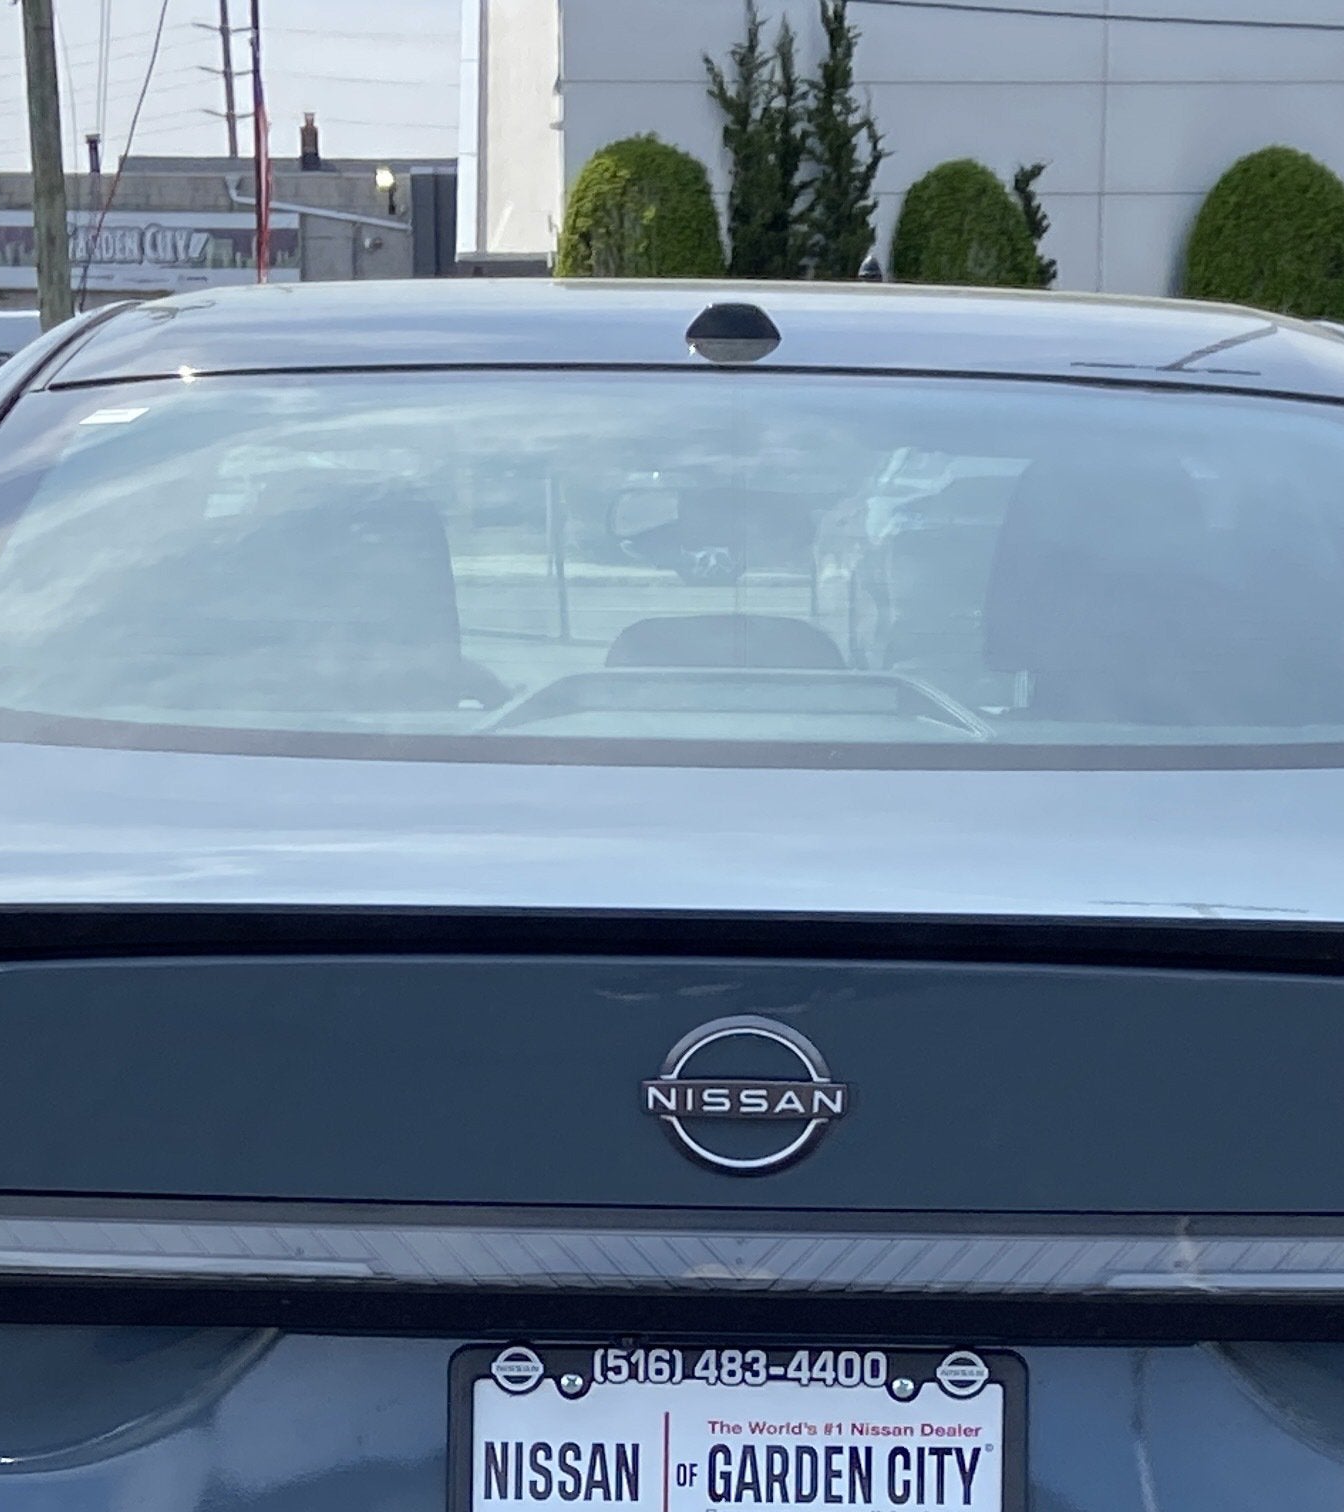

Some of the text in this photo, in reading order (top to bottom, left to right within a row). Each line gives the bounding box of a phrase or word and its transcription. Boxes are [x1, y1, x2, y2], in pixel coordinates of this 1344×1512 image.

[68, 226, 142, 262] ARDEN
[647, 1087, 843, 1113] NISSAN
[593, 1349, 888, 1387] (516) 483-4400
[707, 1420, 983, 1438] The World's #1 Nissan Dealer
[484, 1441, 640, 1502] NISSAN
[676, 1443, 982, 1505] OF GARDEN CITY
